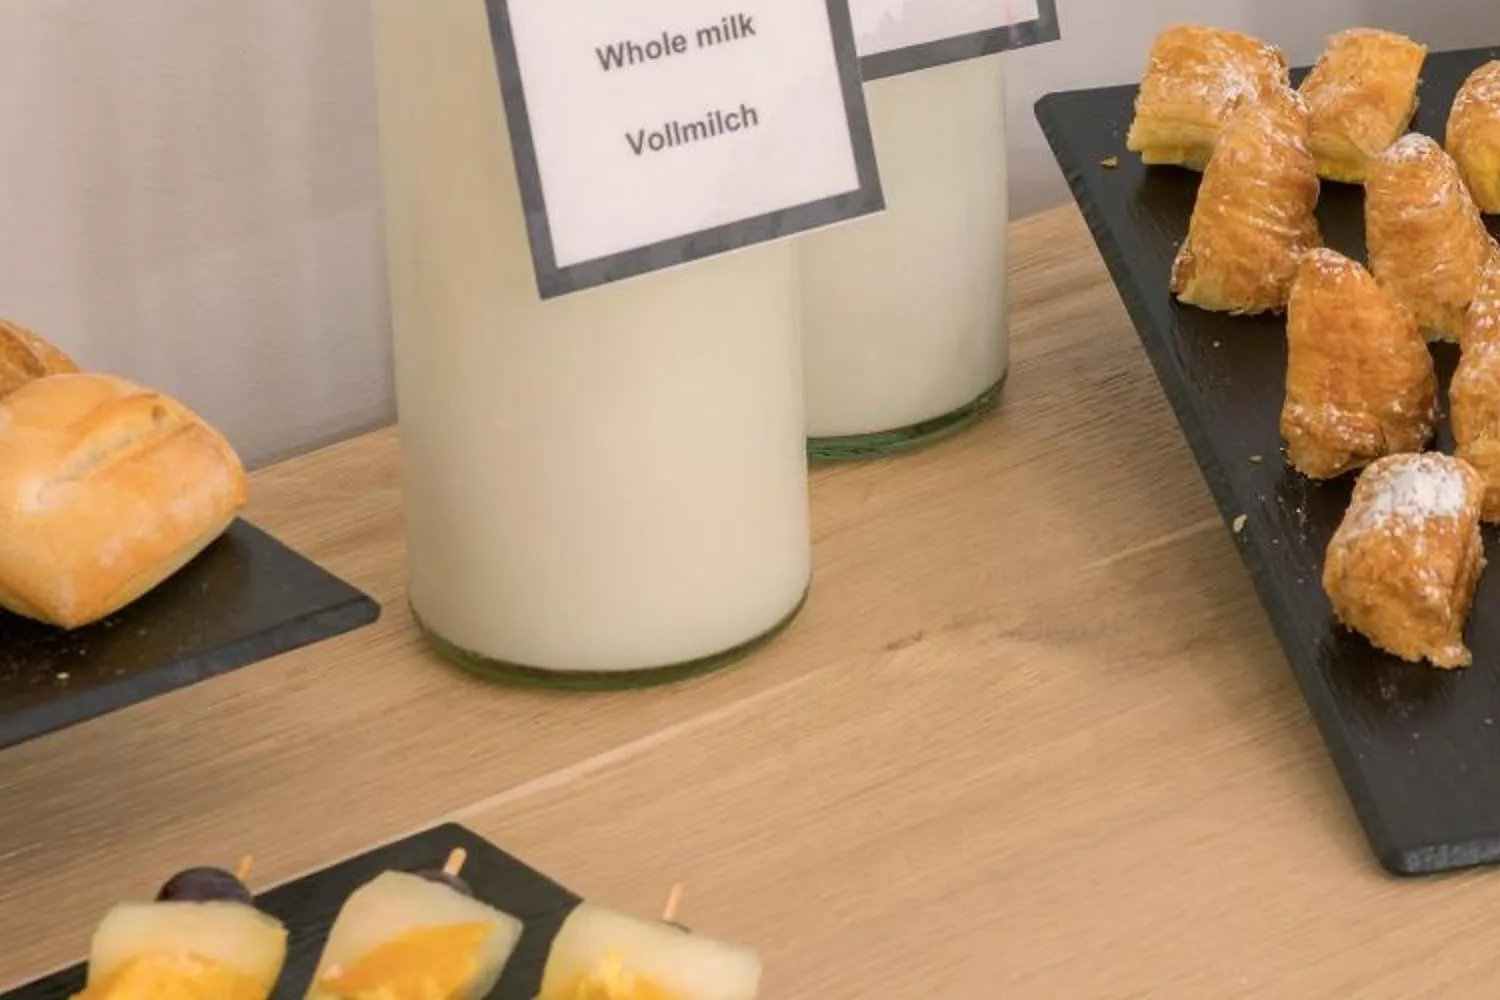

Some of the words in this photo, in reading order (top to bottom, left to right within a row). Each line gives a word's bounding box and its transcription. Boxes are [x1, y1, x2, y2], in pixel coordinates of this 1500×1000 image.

[594, 30, 688, 73] Whole
[695, 12, 757, 49] milk
[624, 102, 760, 157] Vollmilch
